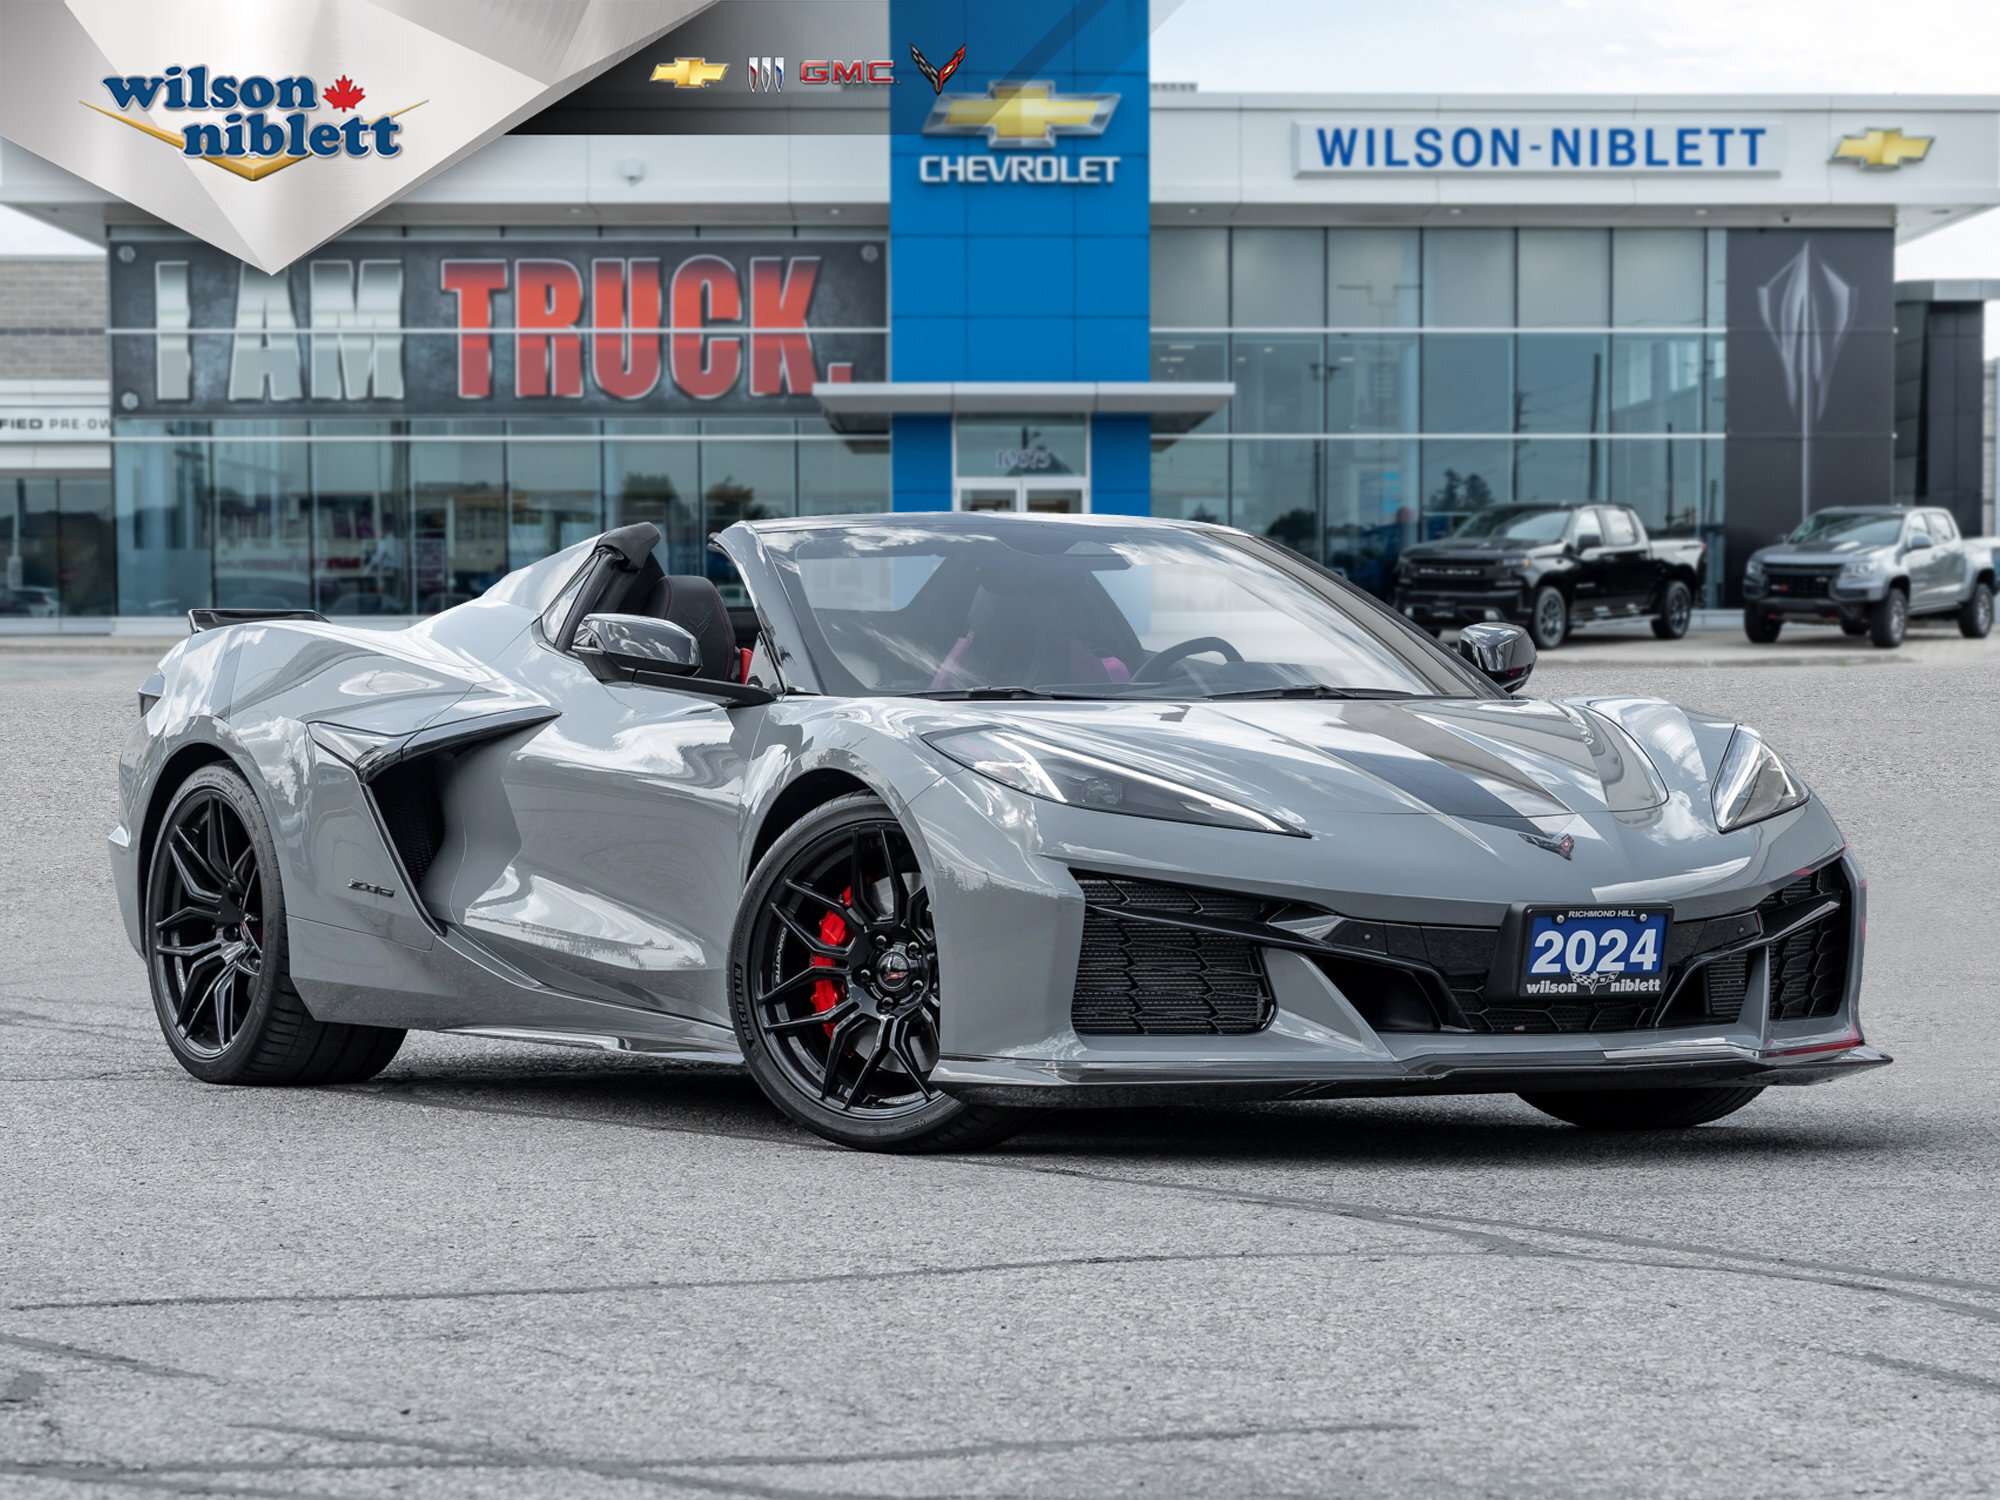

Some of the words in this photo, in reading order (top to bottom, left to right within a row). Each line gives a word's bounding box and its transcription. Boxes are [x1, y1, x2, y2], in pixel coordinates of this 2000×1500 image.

[1316, 126, 1767, 168] WILSON-NIBLETT
[919, 155, 1121, 184] CHEVROLET
[154, 260, 192, 400] I
[228, 259, 405, 401] AM
[1568, 910, 1616, 918] RICHMOND
[1617, 909, 1637, 918] HILL
[1531, 928, 1657, 974] 2024
[1526, 979, 1578, 994] wilson
[1609, 978, 1661, 993] niblett
